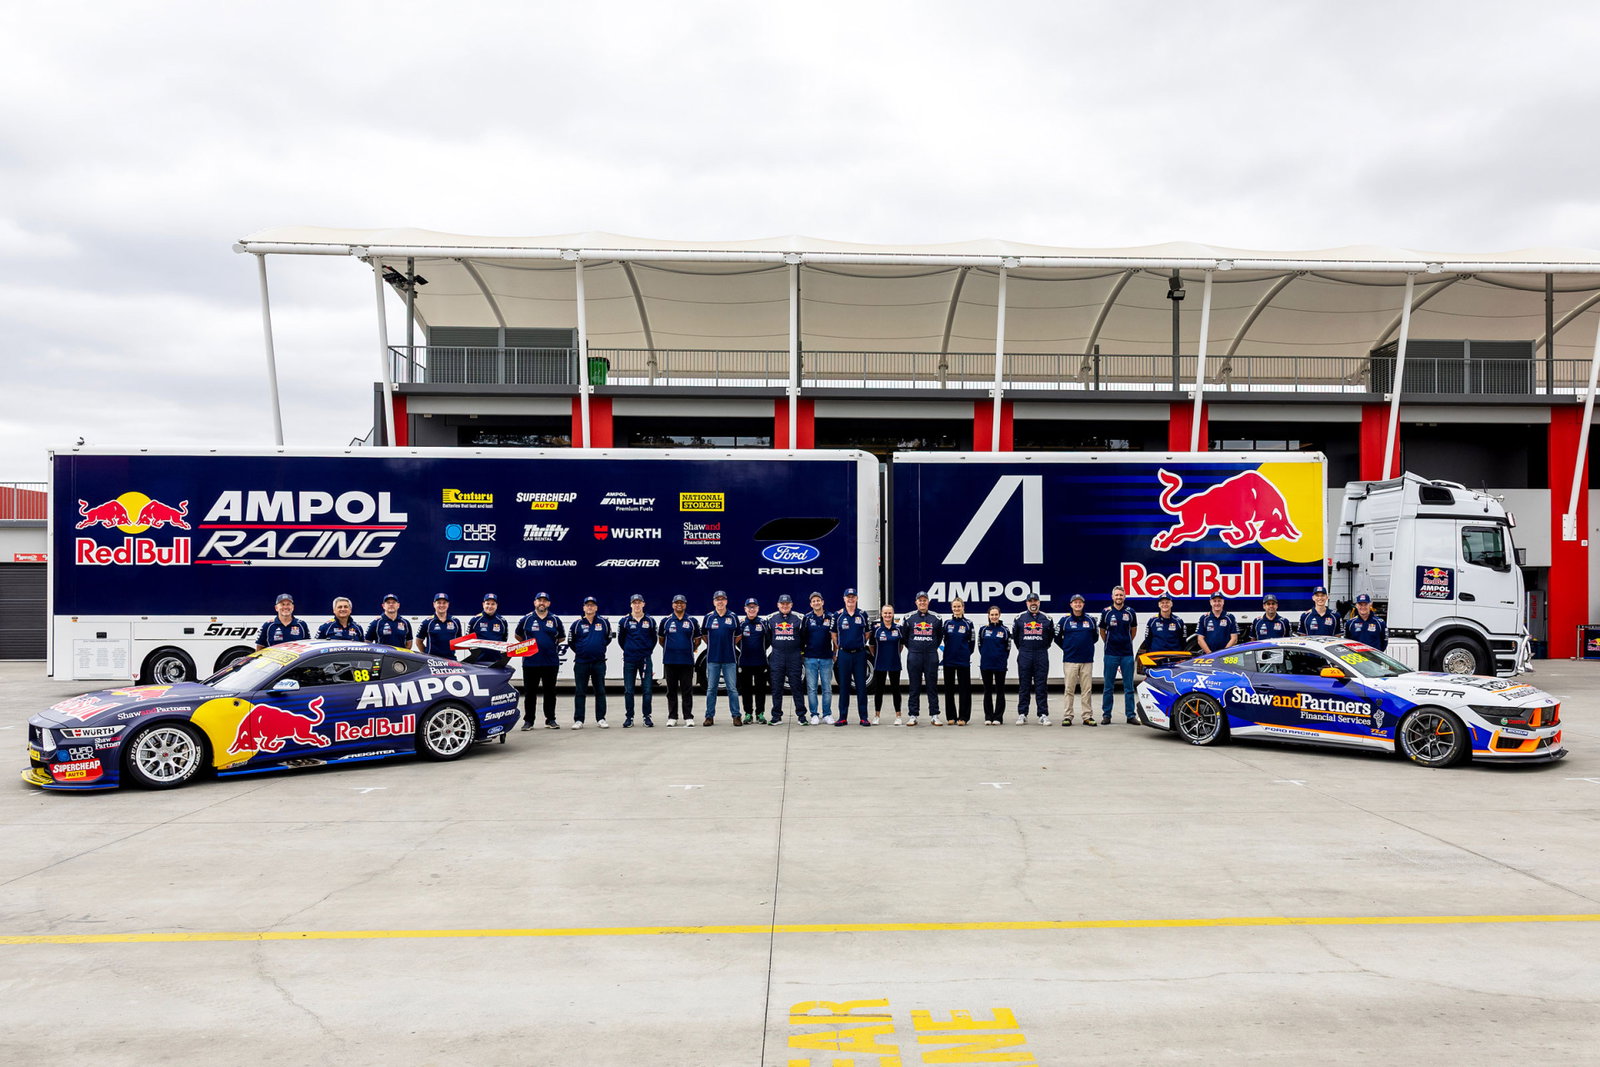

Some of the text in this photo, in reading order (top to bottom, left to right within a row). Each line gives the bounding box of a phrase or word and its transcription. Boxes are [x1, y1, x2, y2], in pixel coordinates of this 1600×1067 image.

[442, 488, 493, 503] Century
[516, 492, 577, 502] SUPERCHEAP
[203, 490, 408, 522] AMPOL
[464, 524, 496, 532] QUAD
[524, 524, 569, 541] Thrifty
[611, 528, 662, 538] WÜRTH
[464, 532, 496, 541] LOCK
[684, 531, 720, 540] Partners
[198, 530, 400, 558] RACING
[773, 546, 808, 560] Ford
[449, 555, 486, 568] JGI
[605, 559, 660, 567] FREIGHTER
[927, 581, 1051, 602] AMPOL
[1223, 656, 1238, 664] 888
[354, 670, 370, 682] 88
[356, 674, 490, 710] AMPOL
[1416, 688, 1465, 698] SCTR
[484, 709, 516, 721] Snap-on
[1300, 712, 1371, 726] Financial Services
[69, 746, 93, 754] QUAD
[131, 729, 150, 762] DUNLOP
[70, 753, 95, 761] LOCK
[345, 750, 395, 758] FREIGHTER
[53, 760, 100, 773] SUPERCHEAP
